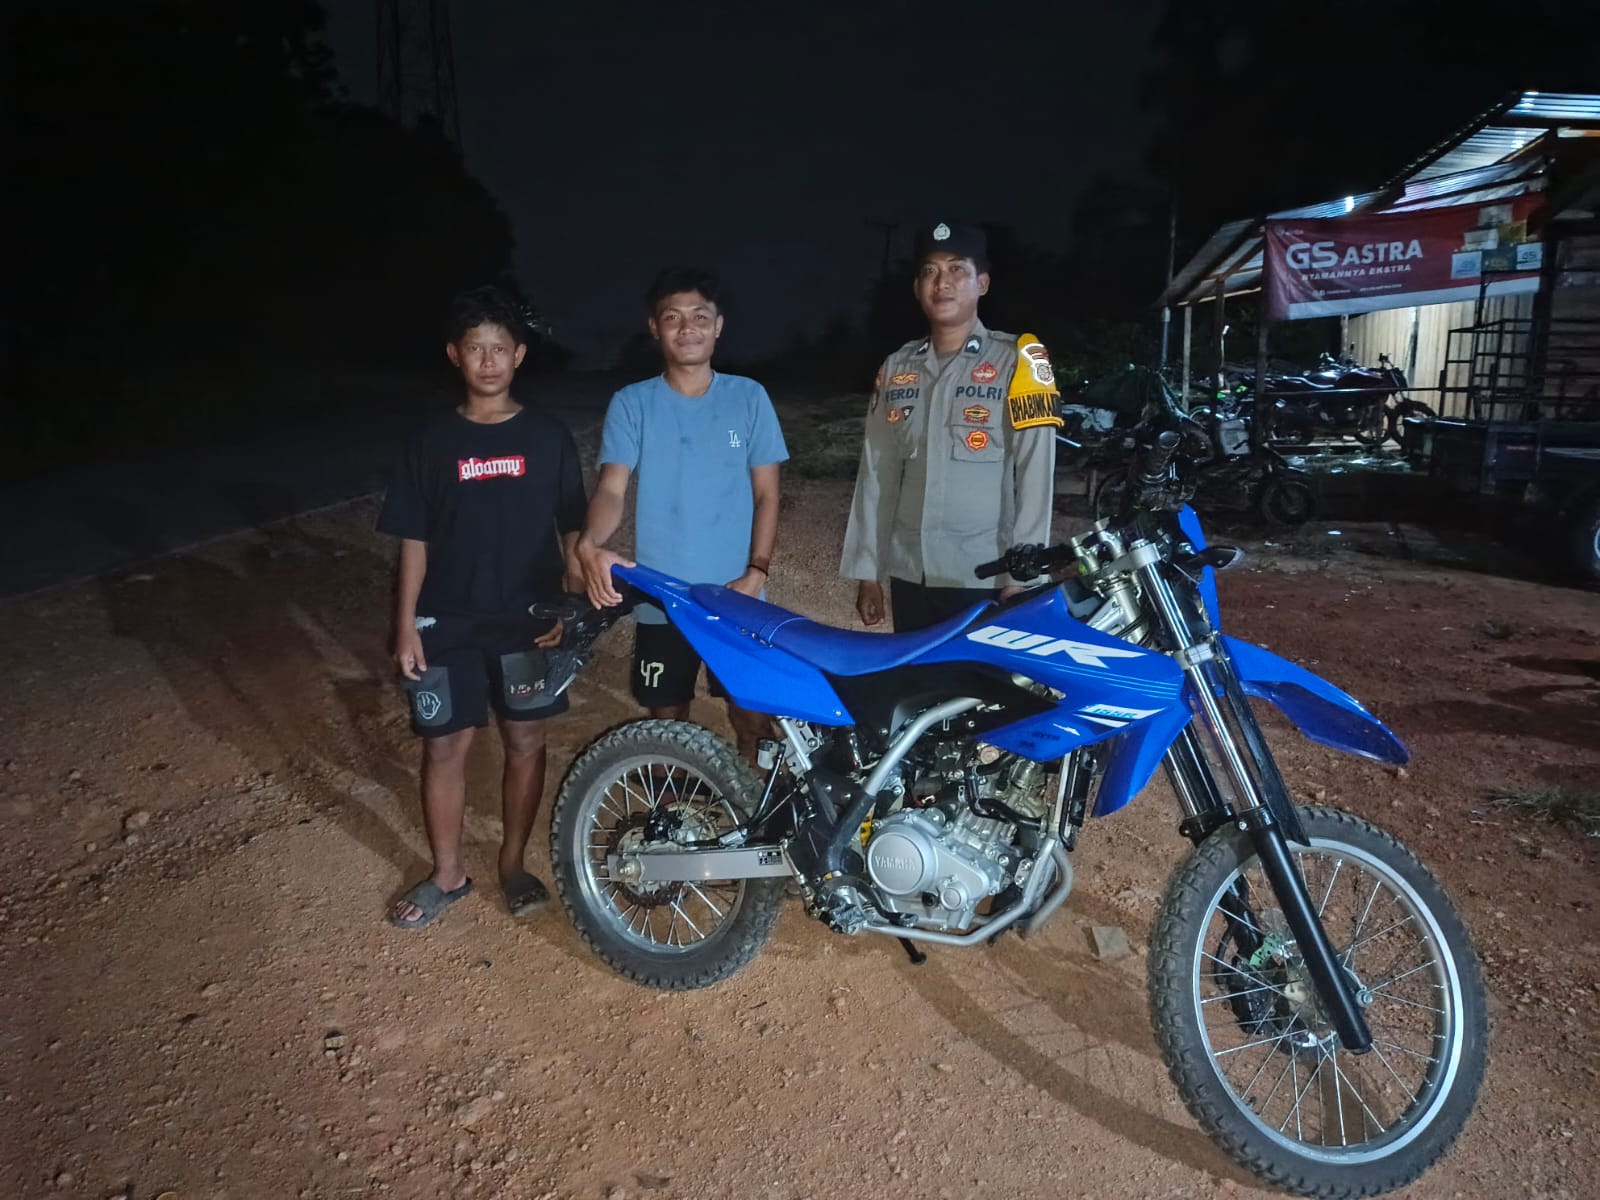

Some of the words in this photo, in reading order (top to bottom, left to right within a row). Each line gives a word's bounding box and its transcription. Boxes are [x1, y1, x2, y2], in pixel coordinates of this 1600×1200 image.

[1286, 240, 1339, 270] GS
[1342, 239, 1424, 267] ASTRA
[1369, 263, 1412, 276] EKSTRA
[955, 385, 1003, 401] POLRI
[728, 429, 742, 448] LA
[461, 457, 520, 480] gloarmy
[966, 625, 1148, 669] WR
[640, 659, 664, 688] 47
[874, 855, 916, 871] YAMAHA
